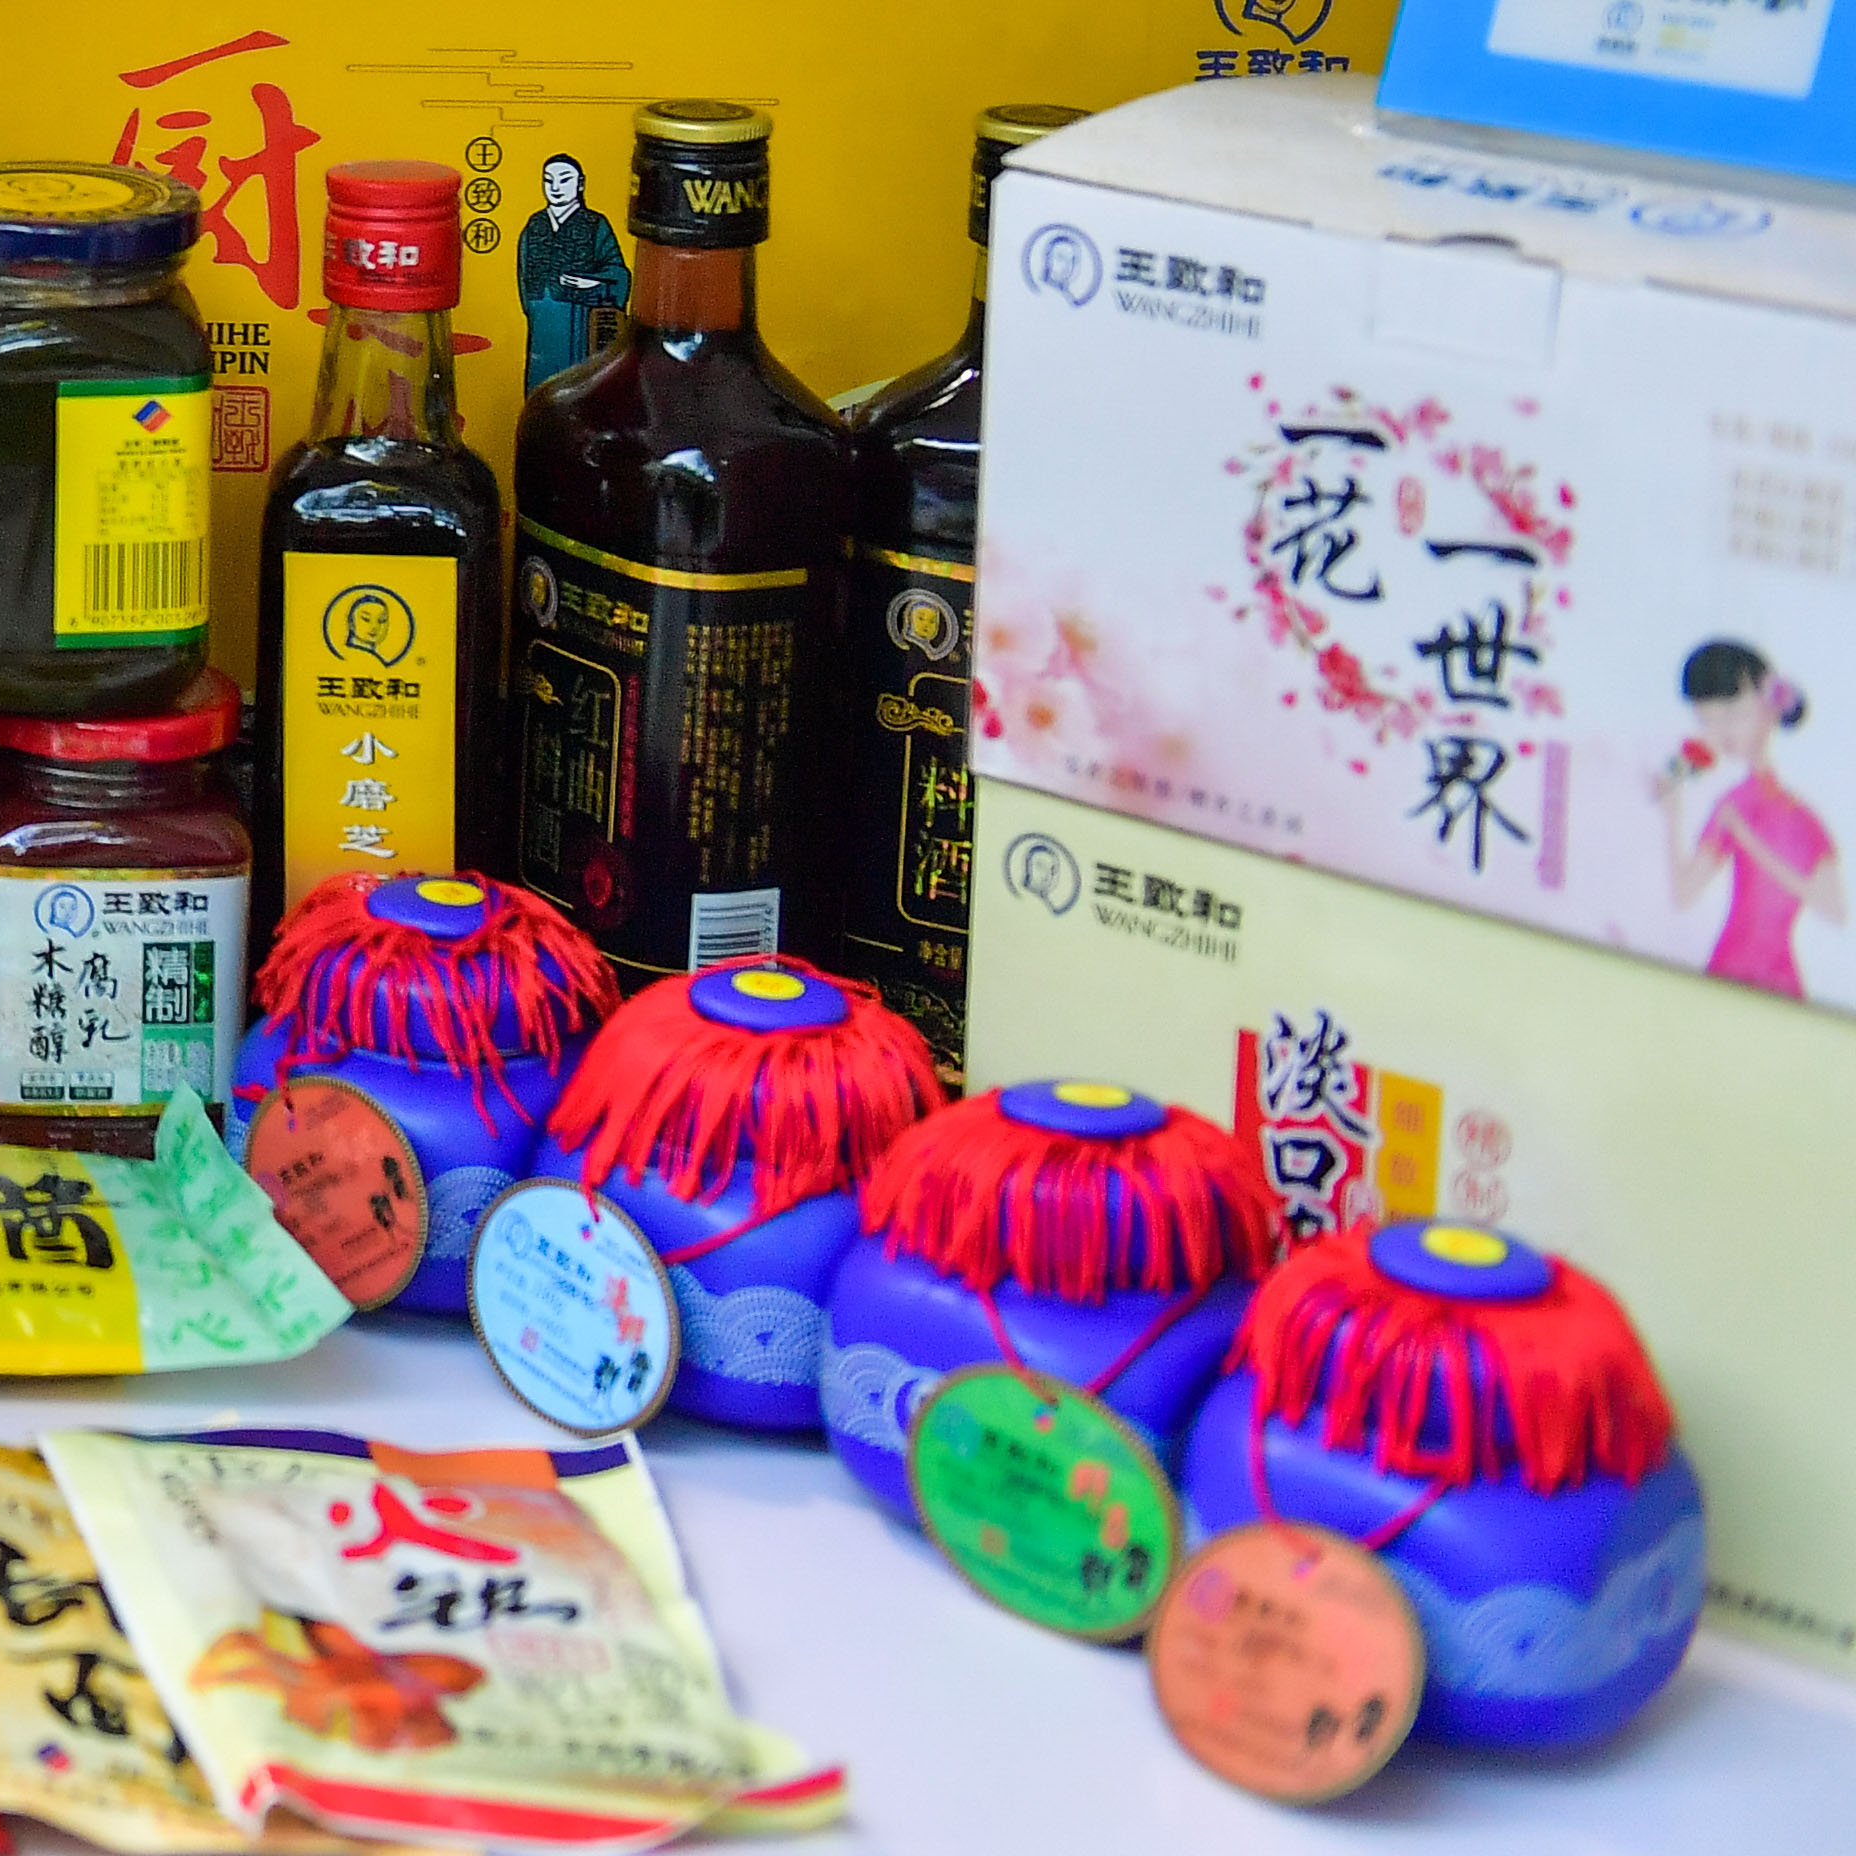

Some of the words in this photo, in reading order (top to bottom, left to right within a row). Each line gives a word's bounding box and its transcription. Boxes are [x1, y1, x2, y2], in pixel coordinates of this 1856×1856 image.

[1194, 51, 1350, 81] 王致和
[465, 136, 502, 253] 王致和
[1113, 246, 1267, 308] 王致和
[1272, 420, 1389, 602] 一花
[316, 675, 422, 700] 王致和
[1408, 537, 1540, 874] 一世界
[338, 731, 399, 882] 小磨芝
[102, 890, 210, 916] 王致和
[1092, 861, 1243, 933] 王致和
[28, 938, 74, 1065] 木糖醇
[73, 950, 132, 1048] 腐乳
[144, 945, 190, 1023] 精制
